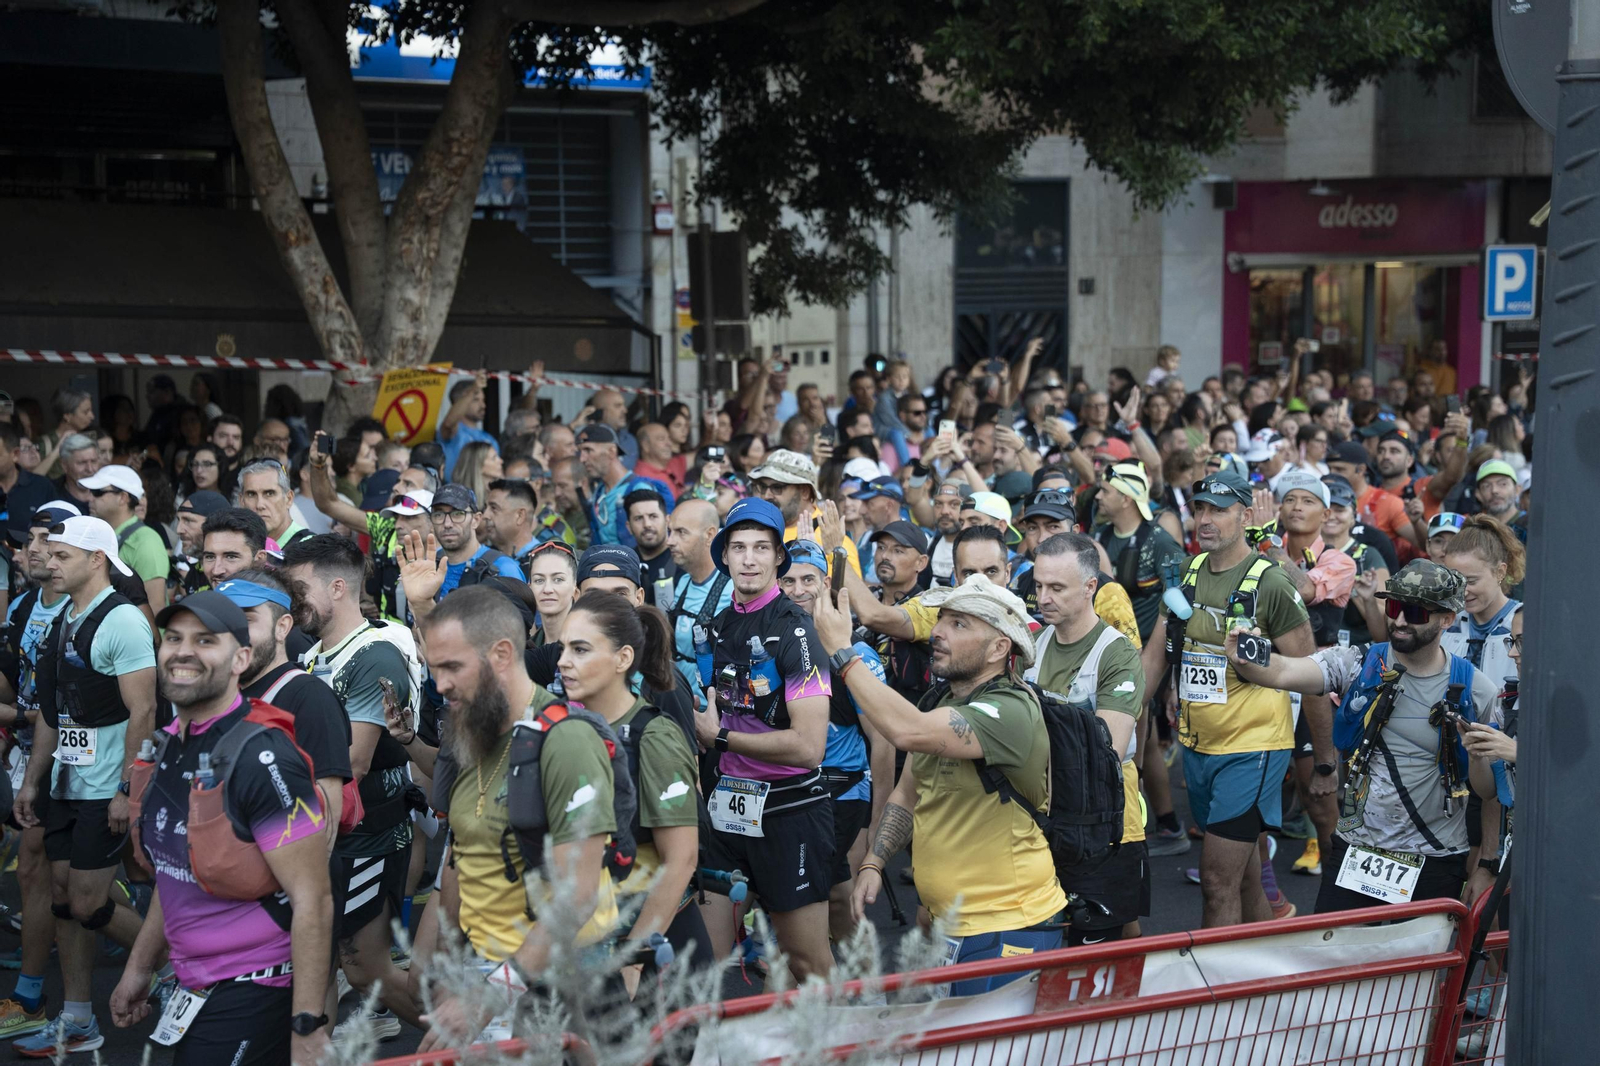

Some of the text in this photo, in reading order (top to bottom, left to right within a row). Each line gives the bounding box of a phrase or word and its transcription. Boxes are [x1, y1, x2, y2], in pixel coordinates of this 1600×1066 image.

[1318, 195, 1398, 228] adesso
[1494, 253, 1526, 312] P
[800, 637, 813, 671] Espabrok
[1185, 667, 1218, 685] 1239
[60, 729, 89, 748] 268
[267, 764, 294, 808] Espabrok
[728, 794, 746, 816] 46
[725, 823, 742, 832] asisa
[1360, 855, 1410, 885] 4317
[1361, 884, 1382, 896] asisa
